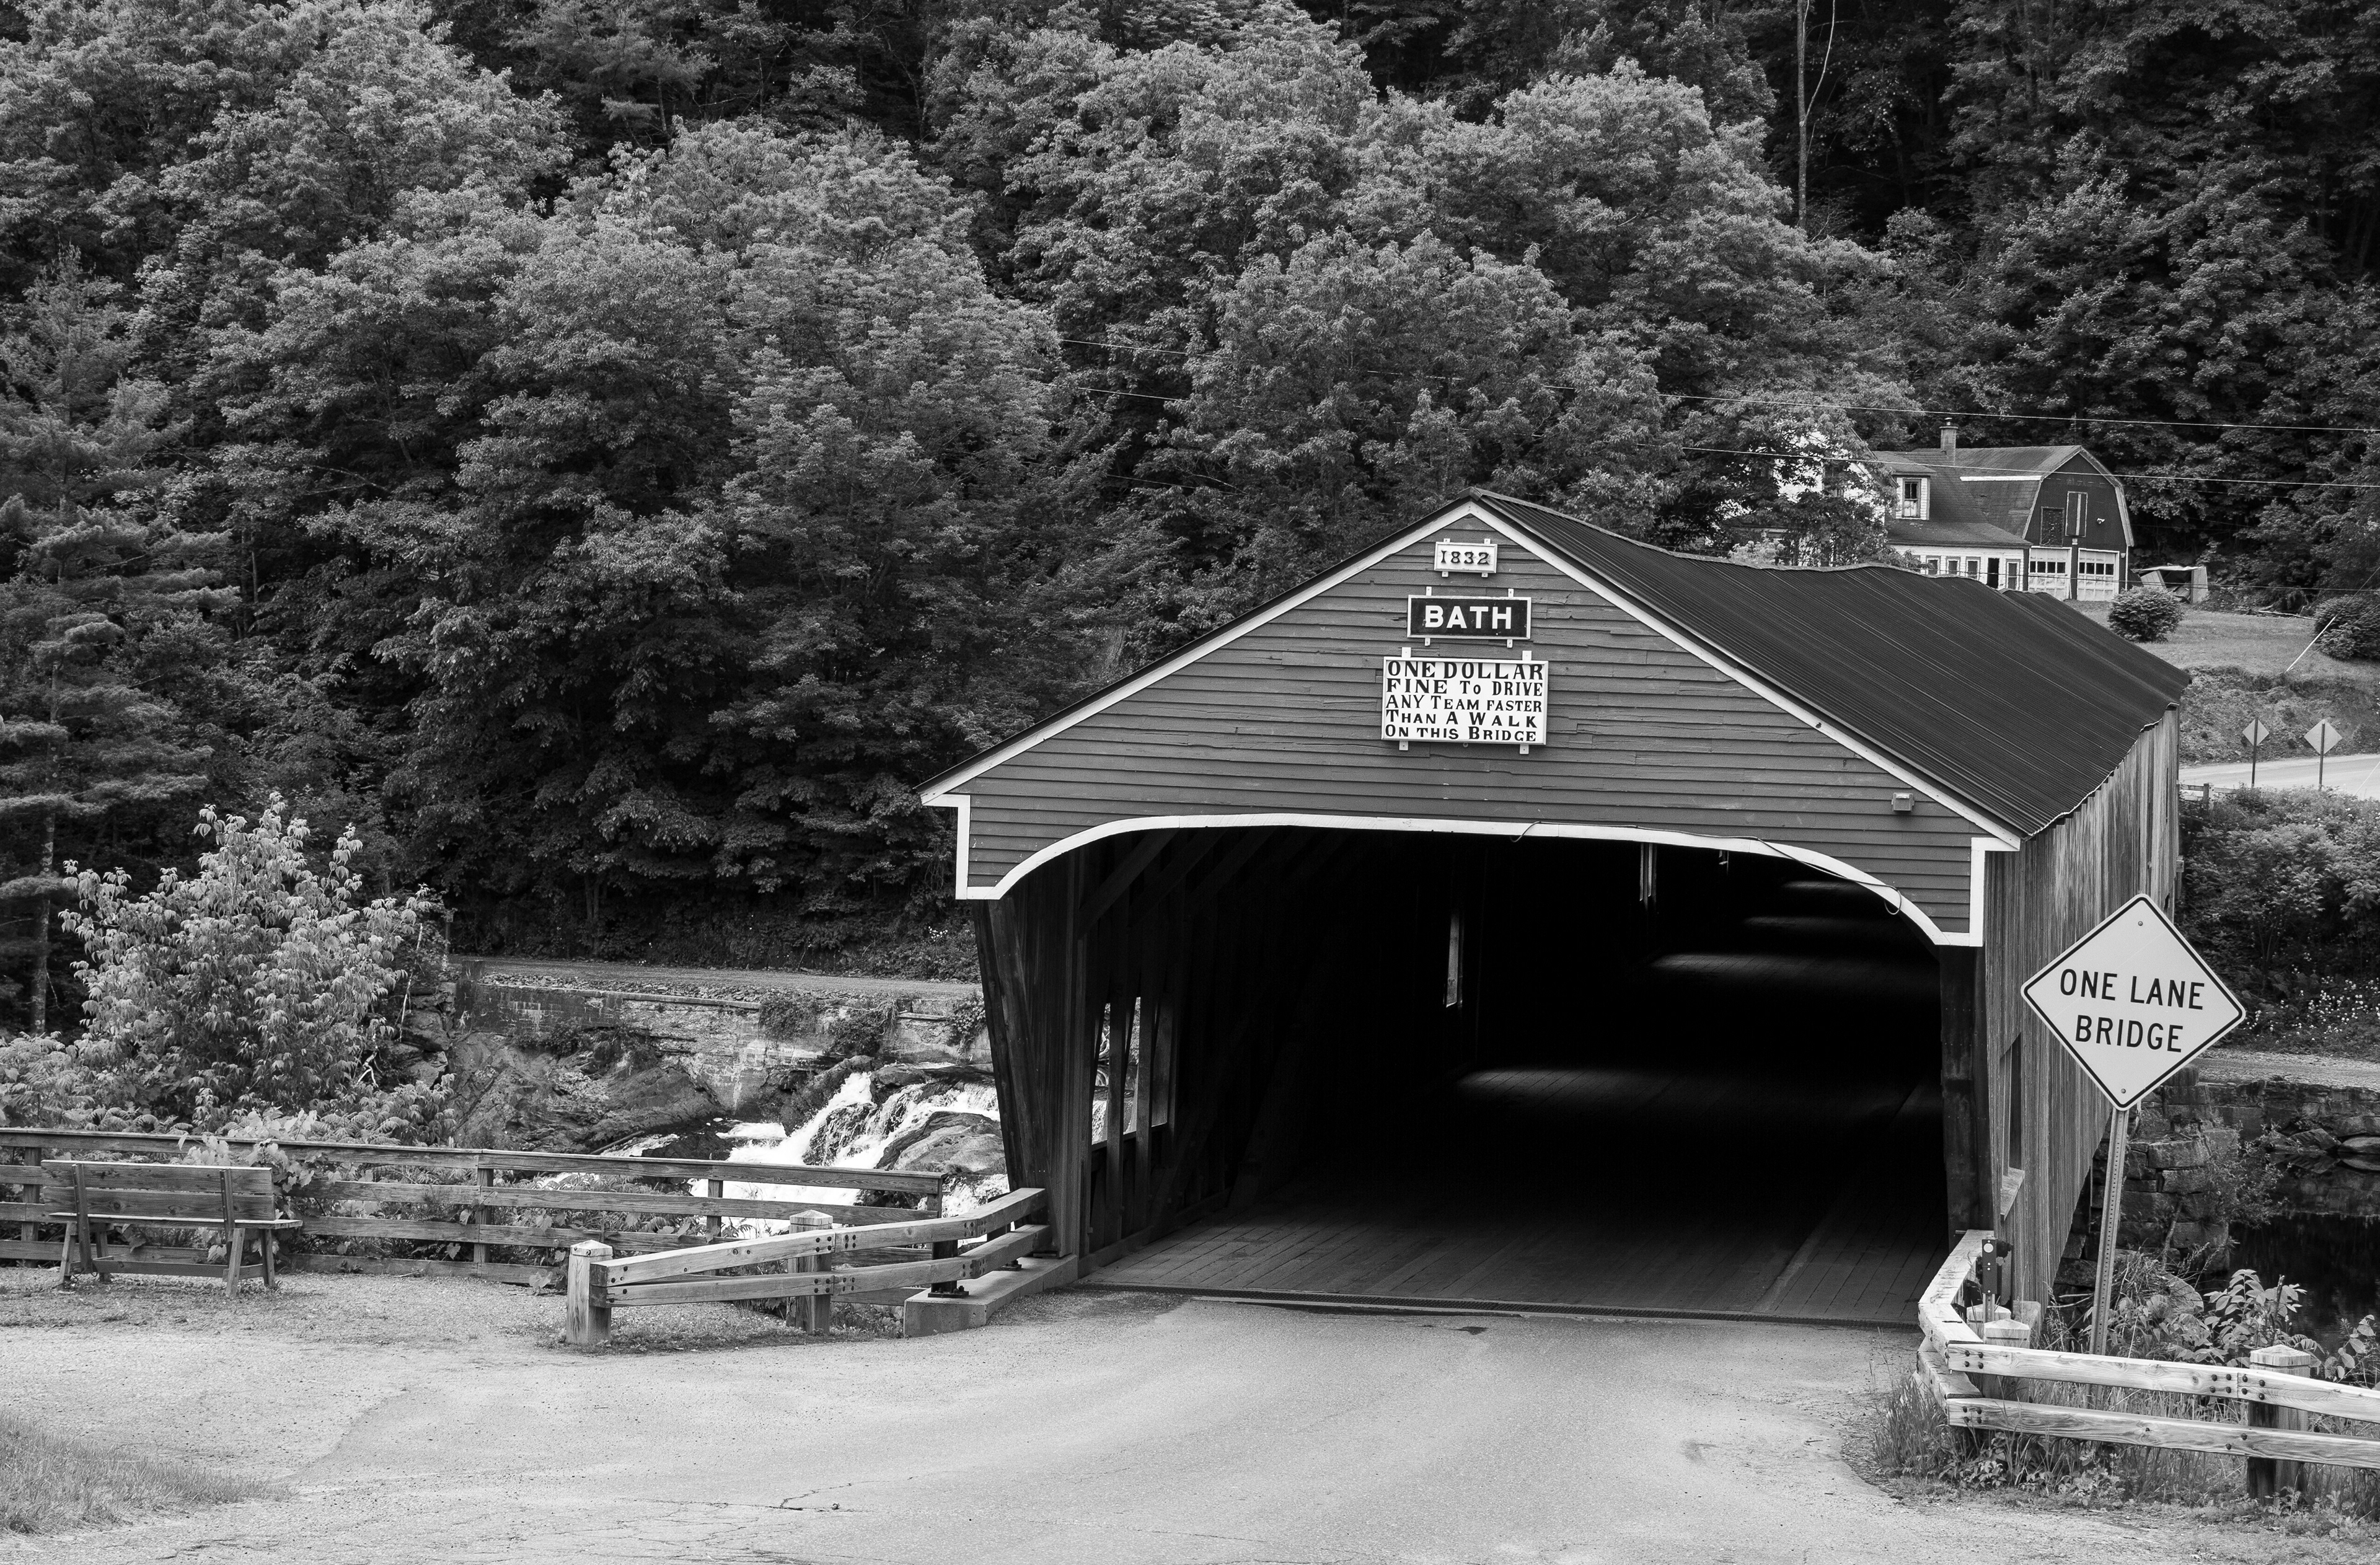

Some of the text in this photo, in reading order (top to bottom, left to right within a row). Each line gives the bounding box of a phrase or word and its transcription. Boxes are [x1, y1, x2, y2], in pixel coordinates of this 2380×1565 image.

[1440, 550, 1491, 565] 1832
[1425, 605, 1512, 629] BATH
[1388, 660, 1543, 680] ONE DOLLAR
[1386, 679, 1447, 694] FINE
[1492, 681, 1543, 696] DRIVE
[1386, 695, 1424, 708] ANY
[1487, 700, 1541, 712] FASTER
[1446, 712, 1458, 725] A
[1470, 712, 1537, 728] WALK
[1385, 724, 1536, 741] ON THIS BRIDGE
[2060, 969, 2205, 1010] ONE LANE
[2075, 1015, 2183, 1053] BRIDGE
